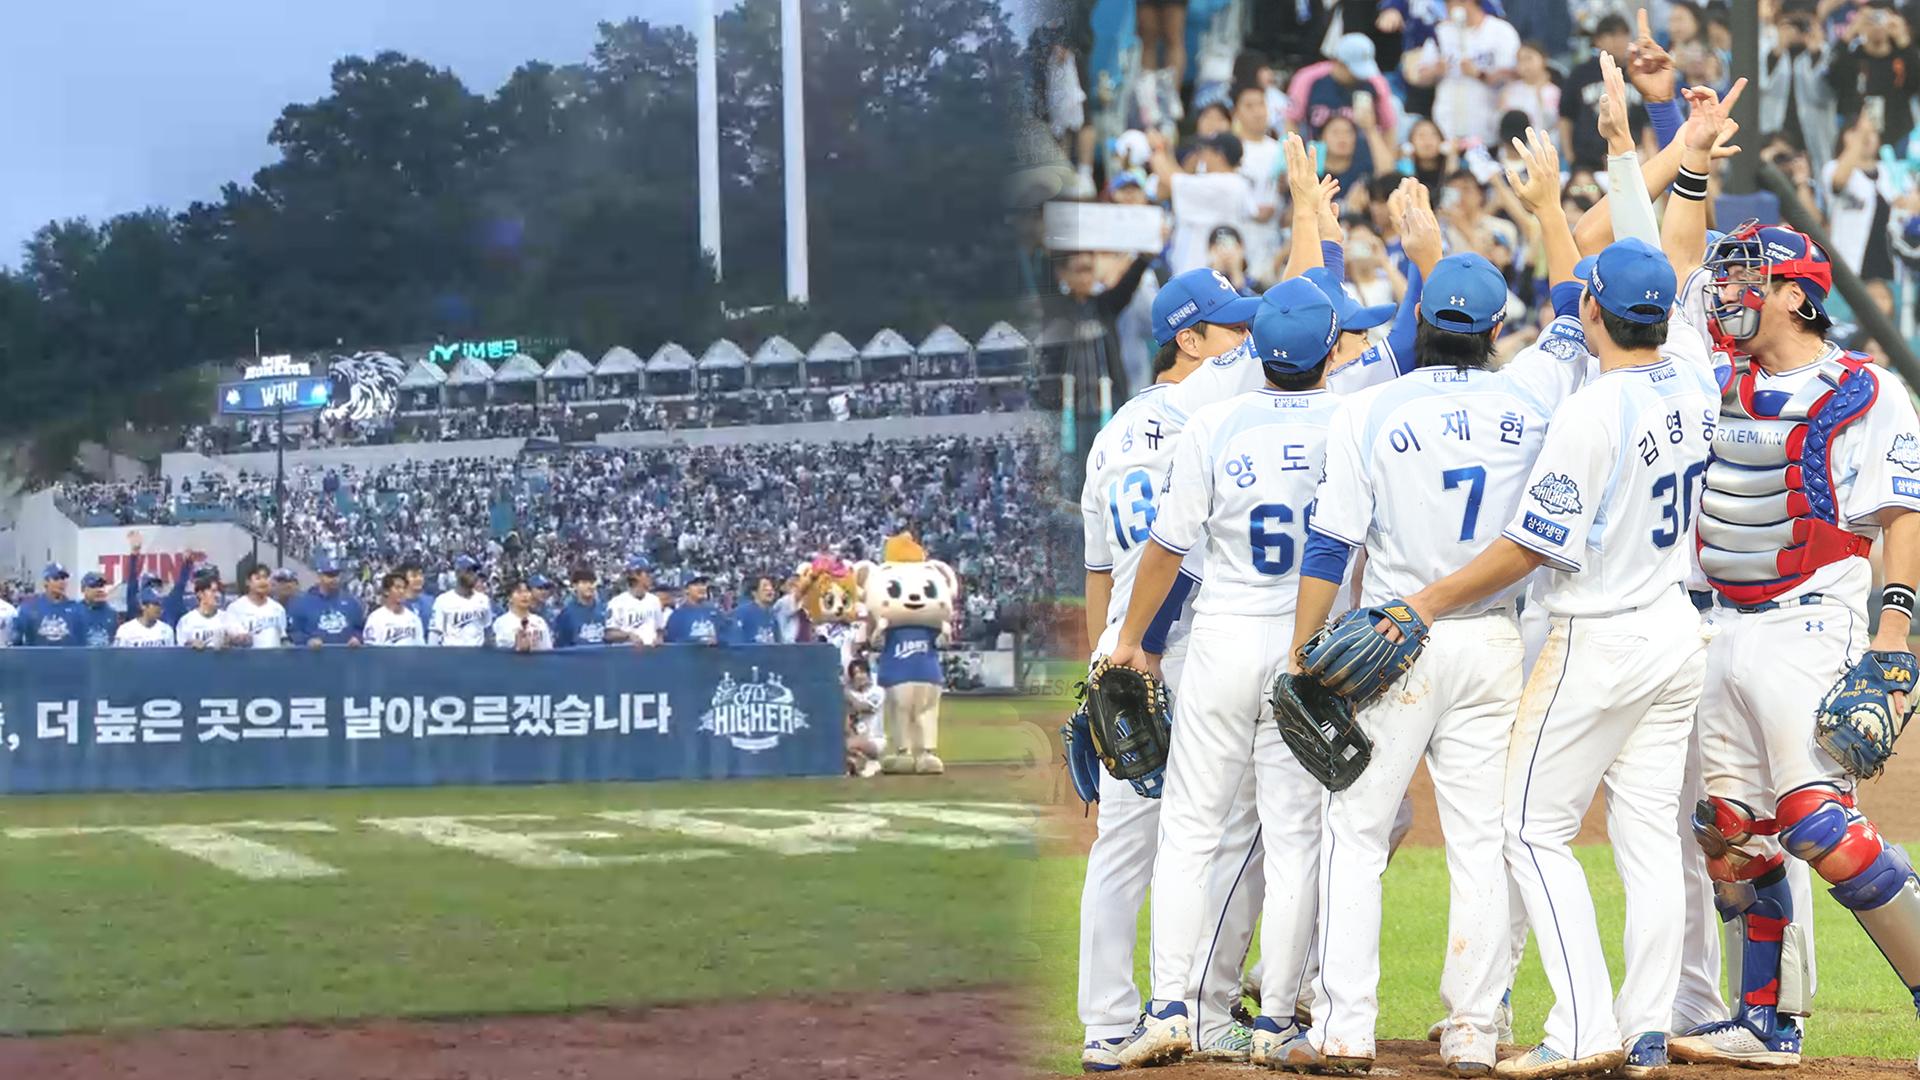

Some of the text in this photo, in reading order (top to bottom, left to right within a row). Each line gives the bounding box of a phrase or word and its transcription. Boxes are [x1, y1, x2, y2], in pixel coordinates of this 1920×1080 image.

[463, 340, 517, 359] iM뱅크
[261, 381, 298, 407] WIN!
[1715, 428, 1784, 446] RAEMIAN
[1109, 469, 1158, 551] 13
[1442, 465, 1487, 543] 7
[1537, 486, 1576, 511] HIGHER
[1250, 503, 1315, 576] 6
[1527, 516, 1566, 541] 삼성생명
[98, 552, 208, 585] TVIN
[37, 700, 80, 744] 더
[94, 699, 184, 744] 높은
[198, 697, 330, 742] 곳으로
[343, 692, 672, 740] 날아오르겠습니다
[714, 703, 794, 737] HIGHER
